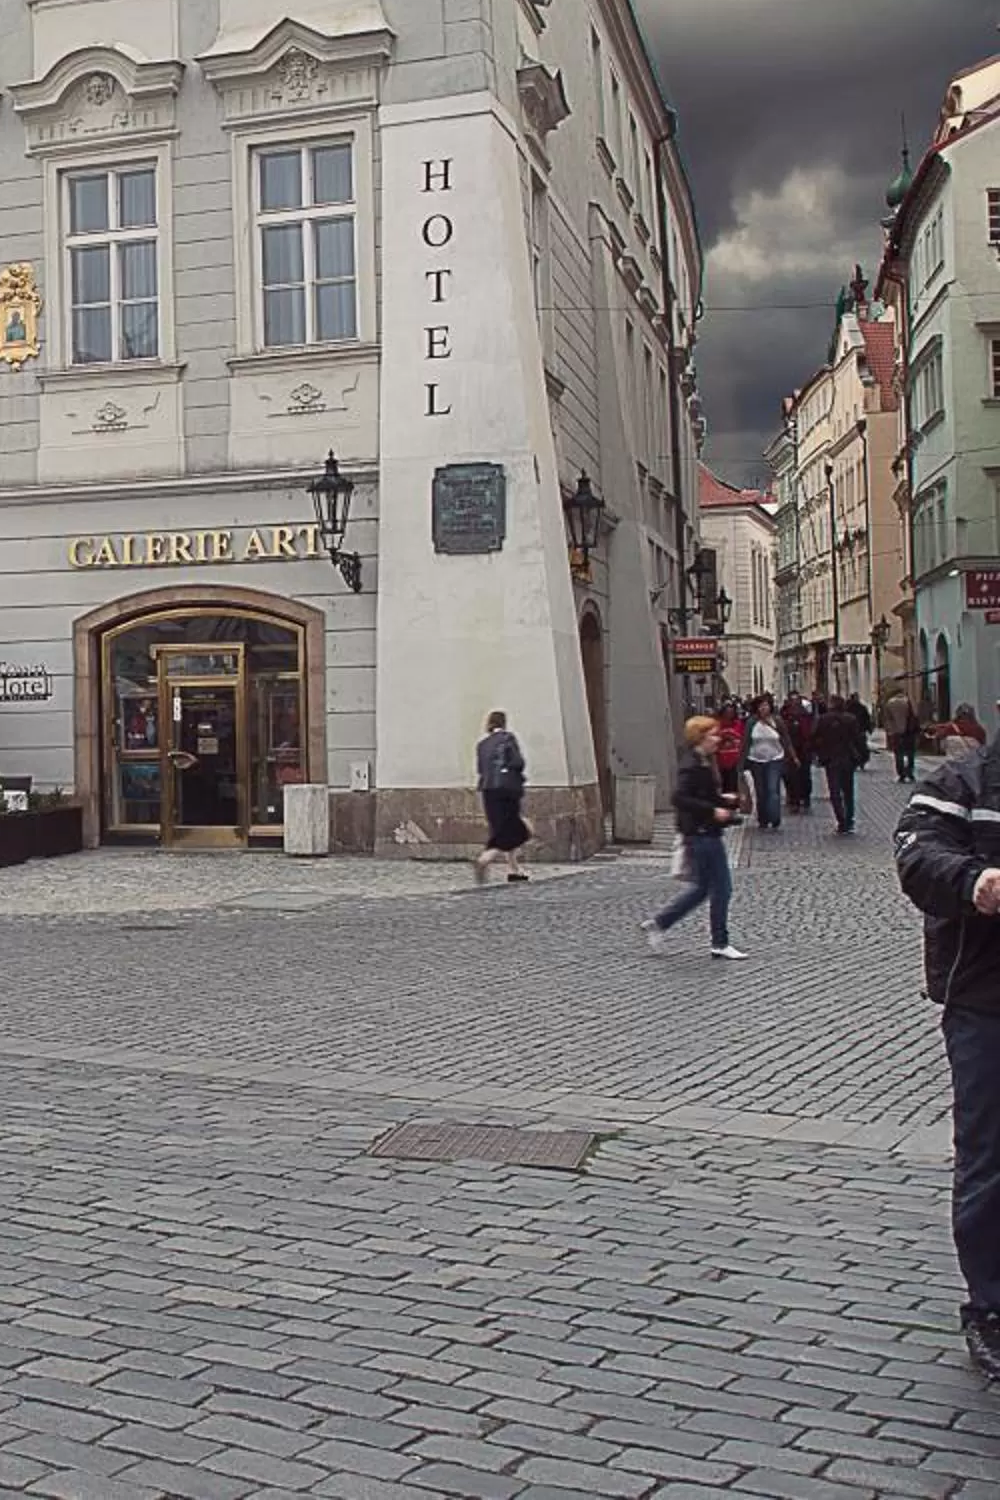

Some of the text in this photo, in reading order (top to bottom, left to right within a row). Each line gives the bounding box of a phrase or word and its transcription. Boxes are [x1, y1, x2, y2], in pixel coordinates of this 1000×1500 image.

[420, 157, 453, 417] HOTEL
[68, 524, 320, 567] GALERIE ART
